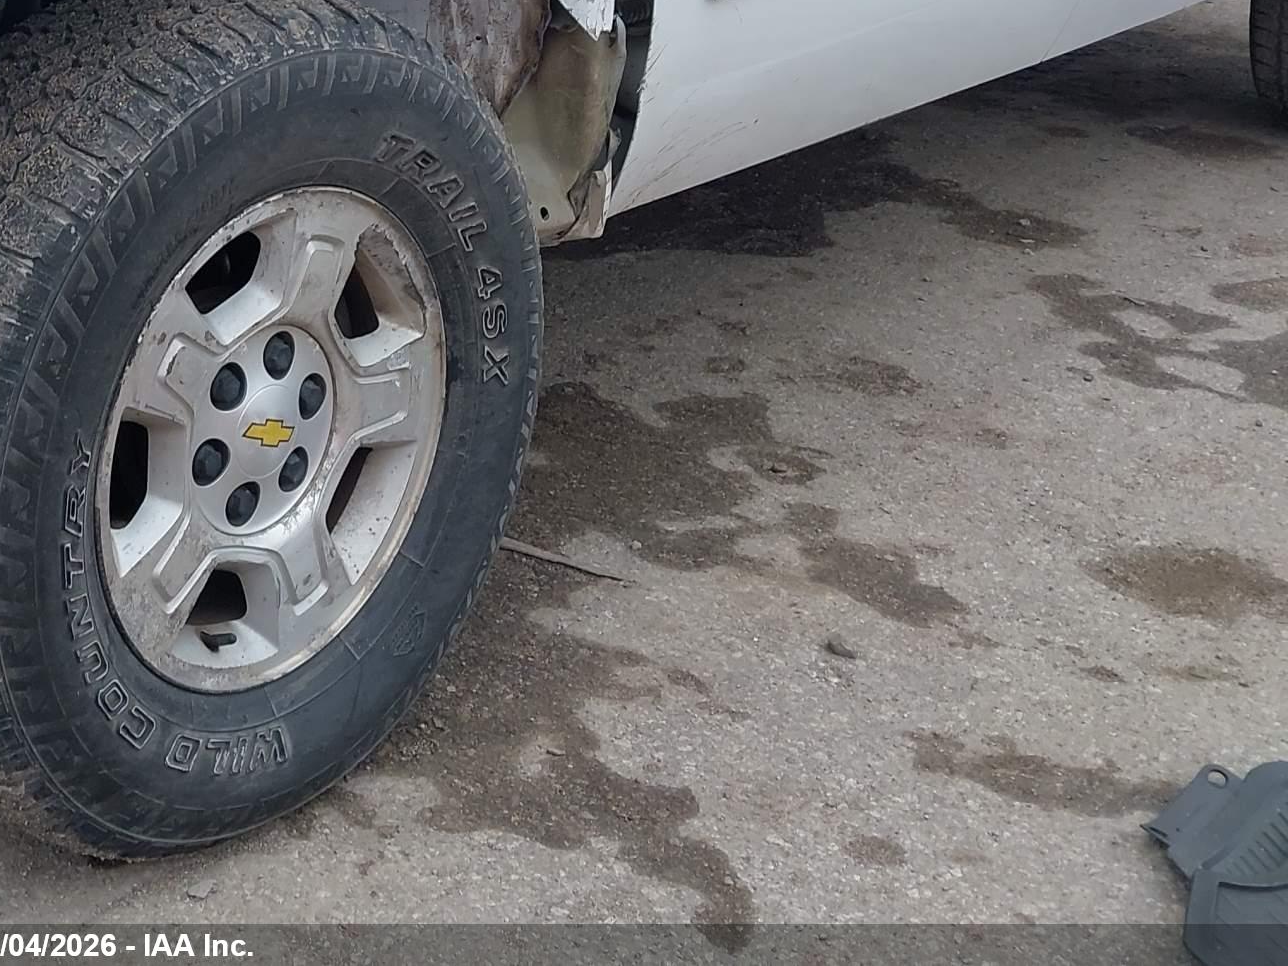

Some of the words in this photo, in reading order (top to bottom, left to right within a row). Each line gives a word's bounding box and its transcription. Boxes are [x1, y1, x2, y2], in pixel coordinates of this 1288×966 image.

[375, 133, 488, 253] TRAIL
[476, 265, 510, 386] 4SX
[63, 434, 157, 752] COUNTRY
[165, 725, 290, 776] WILD
